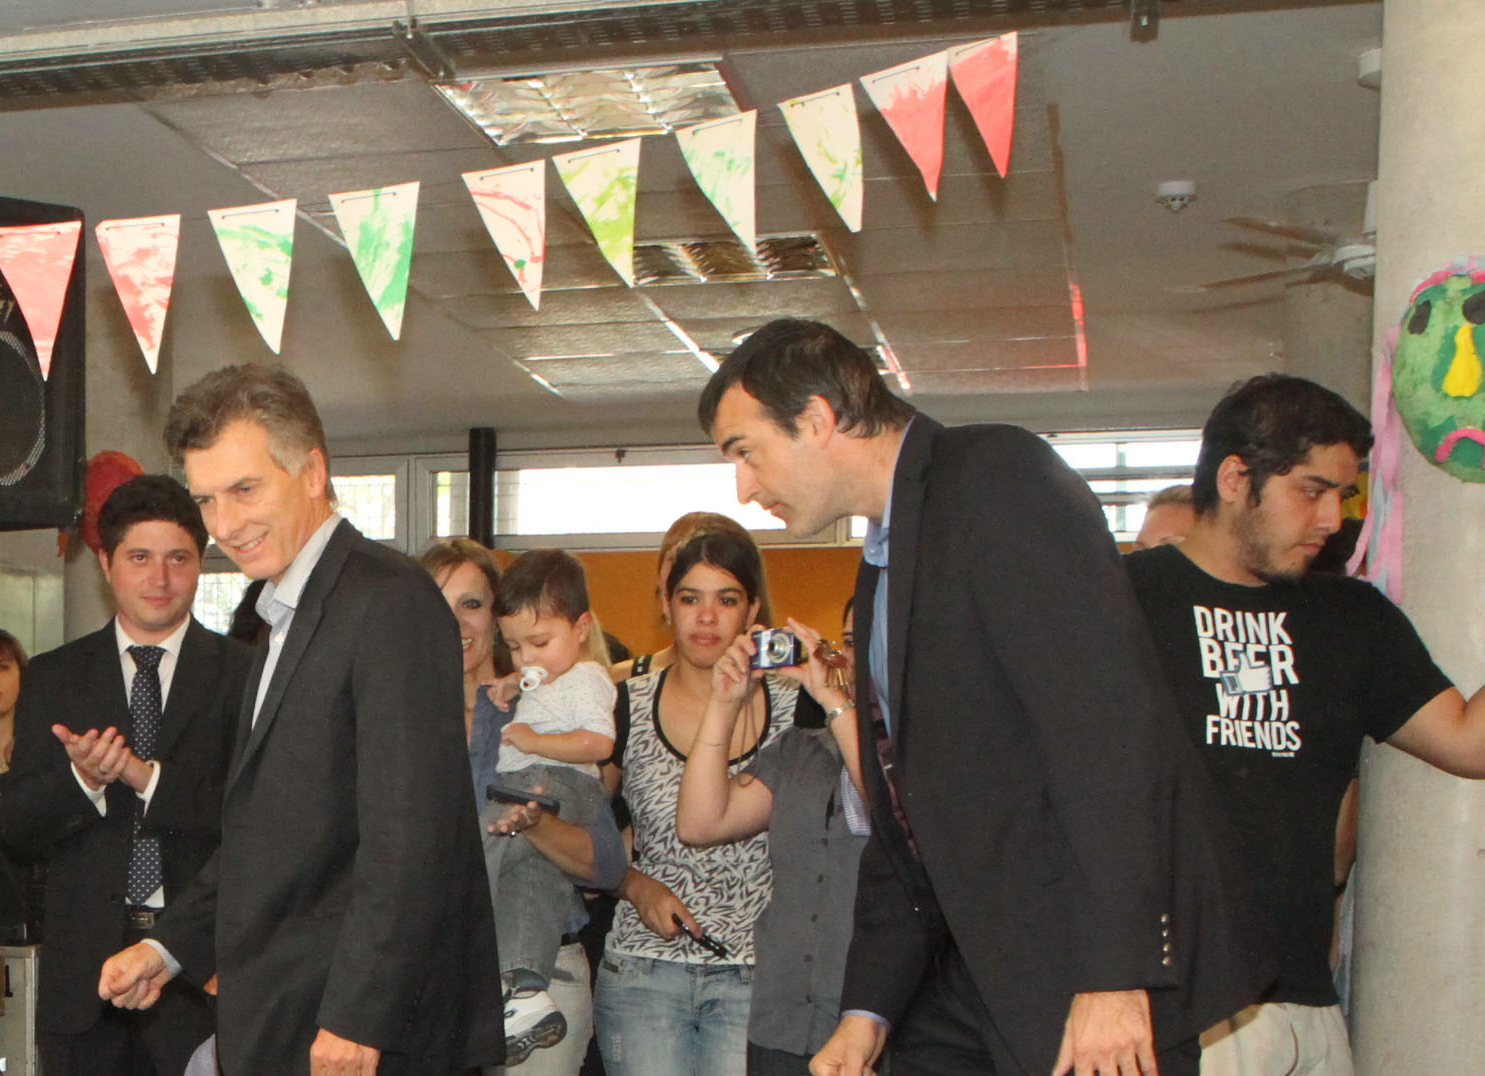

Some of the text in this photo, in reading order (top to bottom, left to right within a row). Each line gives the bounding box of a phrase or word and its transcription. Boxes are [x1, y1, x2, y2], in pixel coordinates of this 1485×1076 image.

[1193, 605, 1293, 645] DRINK
[1199, 637, 1300, 685] BEER
[1216, 683, 1289, 721] WITH
[1206, 715, 1302, 751] FRIENDS
